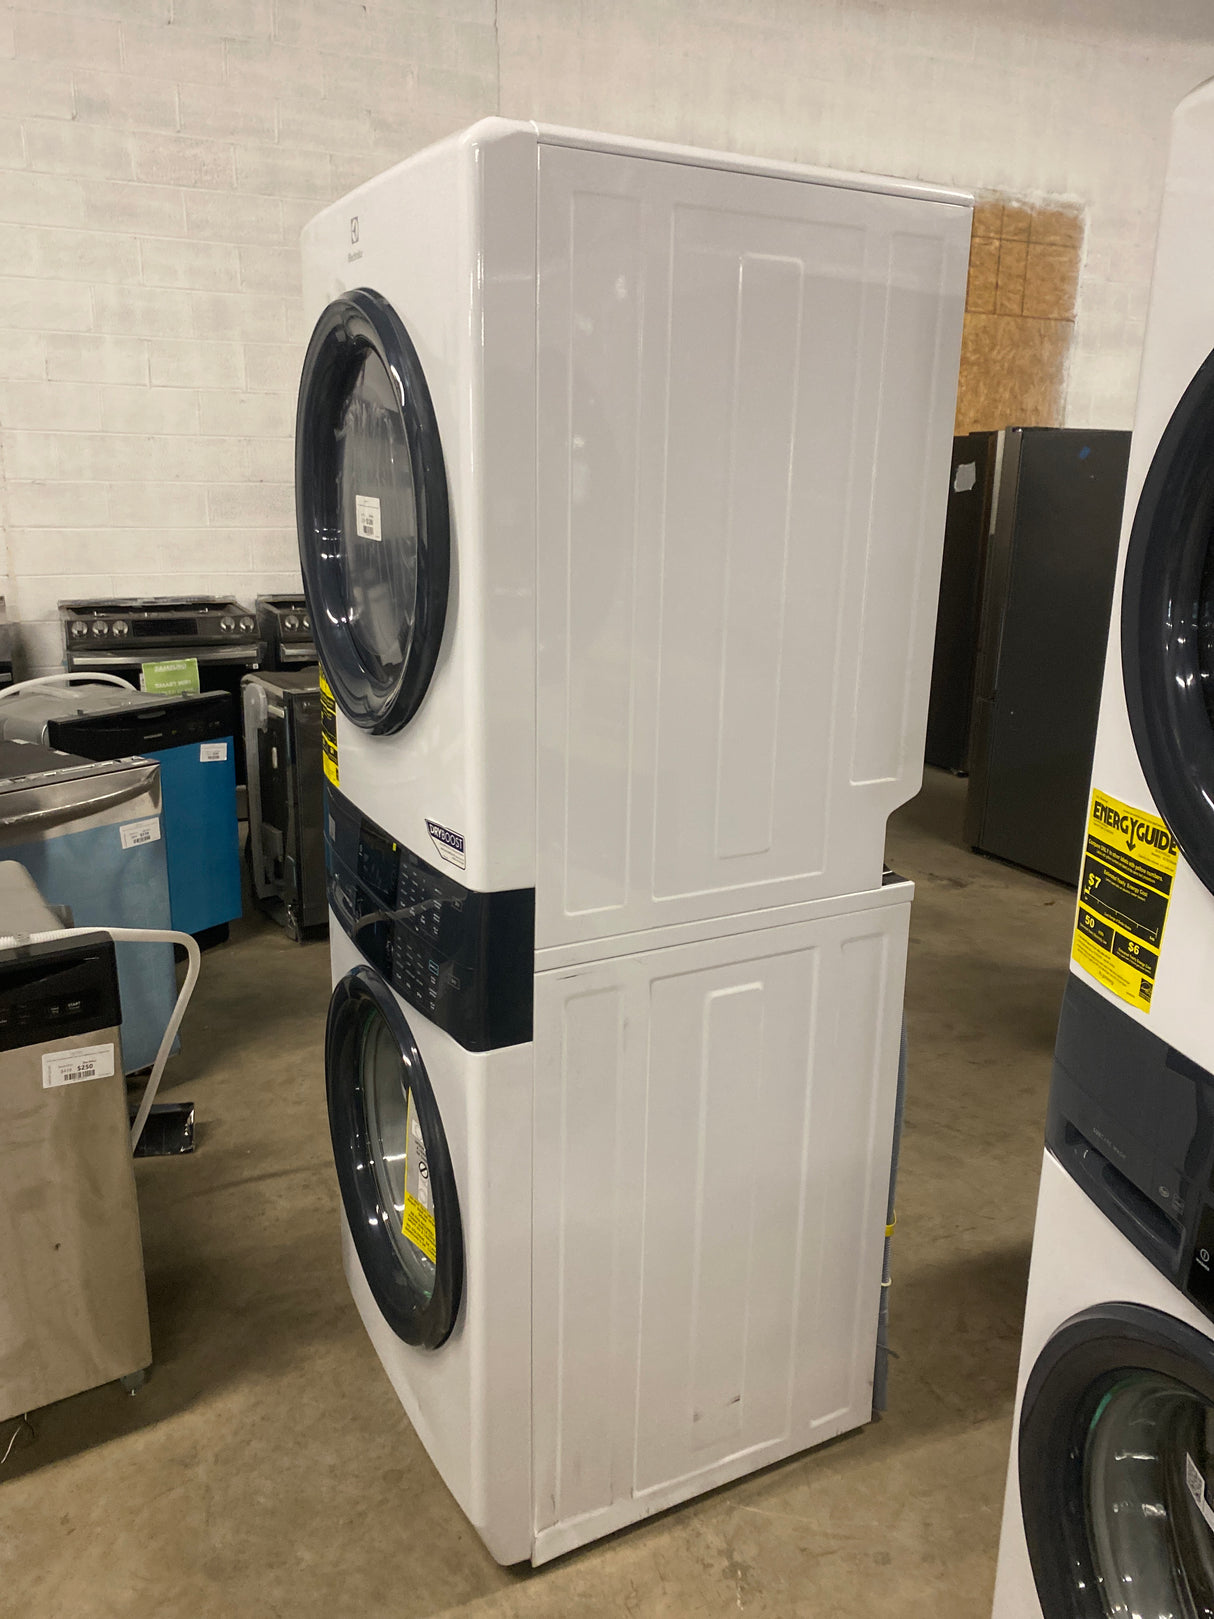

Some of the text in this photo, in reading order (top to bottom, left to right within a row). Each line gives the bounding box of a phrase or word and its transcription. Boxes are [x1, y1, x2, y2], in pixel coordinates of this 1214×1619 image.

[1093, 800, 1177, 856] ENERGYGUIDE
[1088, 873, 1101, 888] $7
[1084, 914, 1095, 928] 50
[1127, 941, 1140, 955] $6
[77, 1063, 93, 1071] $250
